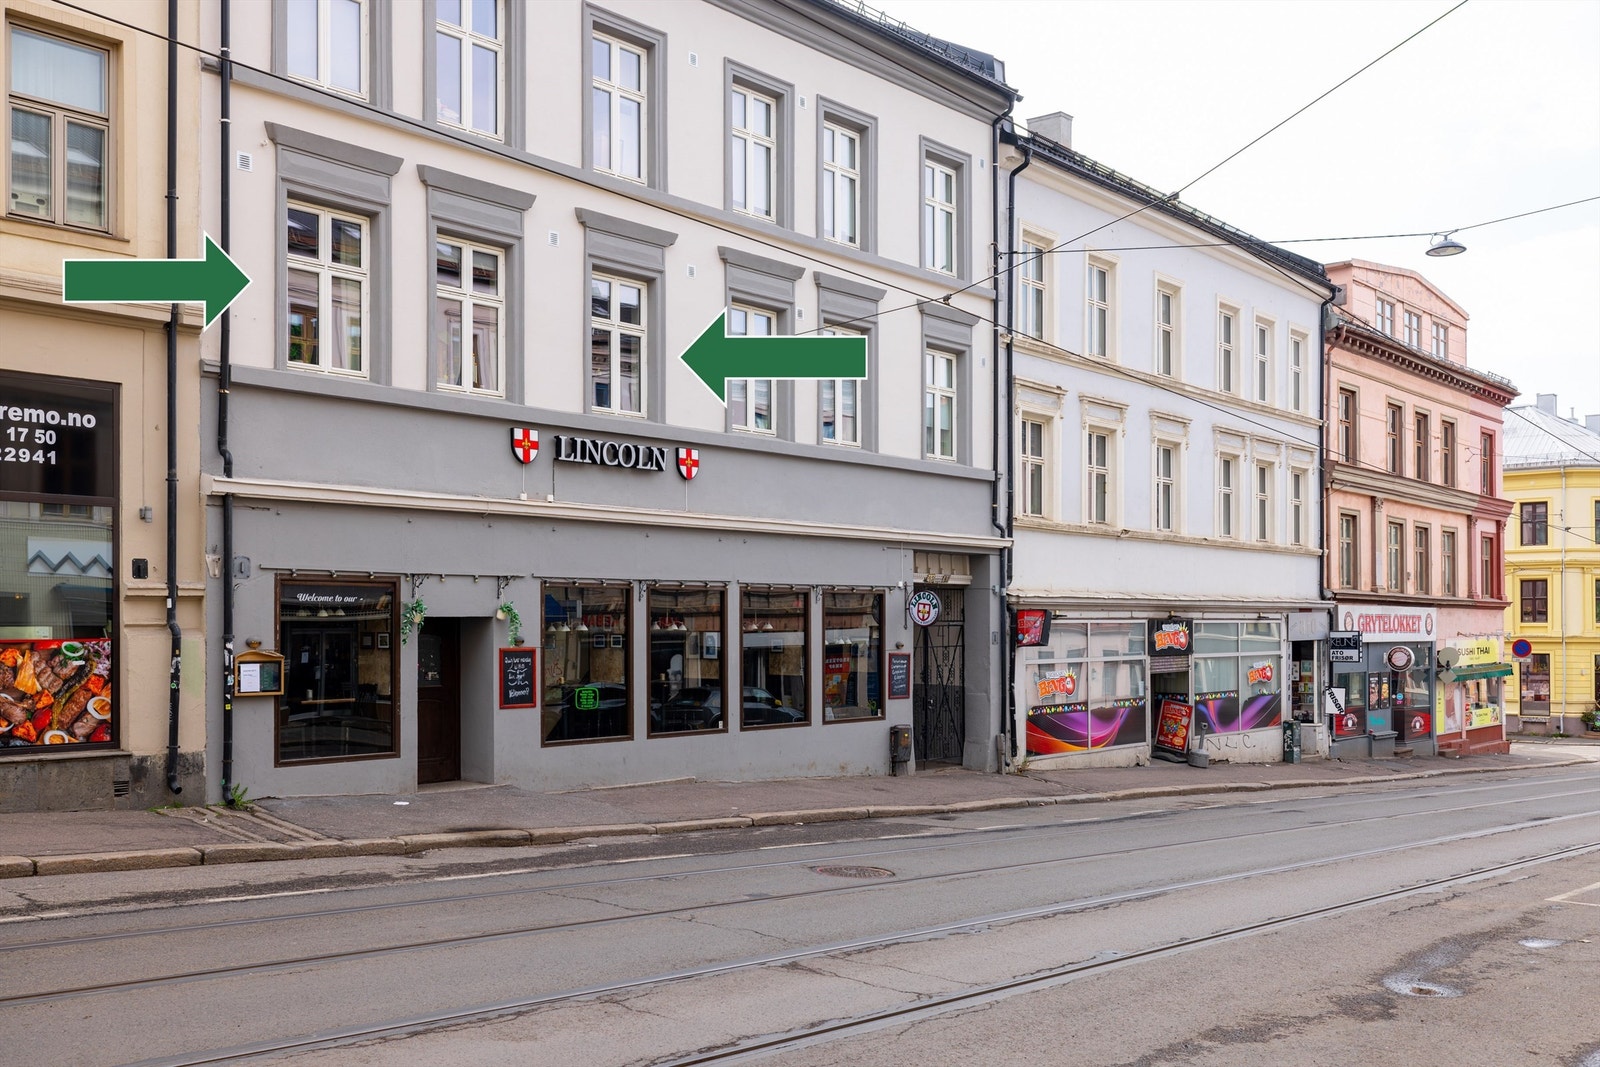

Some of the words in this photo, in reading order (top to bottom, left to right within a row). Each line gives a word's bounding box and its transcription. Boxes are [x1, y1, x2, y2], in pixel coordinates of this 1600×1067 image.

[6, 426, 29, 442] 17
[34, 429, 57, 445] 50
[0, 447, 56, 465] 2941
[555, 435, 669, 472] LINCOLN
[296, 593, 334, 603] Welcome
[334, 594, 343, 603] to
[910, 592, 938, 610] LINCOLN
[1357, 613, 1422, 634] GRYTELOKKET
[1154, 630, 1189, 650] BINGO
[1331, 637, 1357, 647] KEUNE
[1457, 647, 1476, 656] SUSHI
[1476, 646, 1490, 655] THAI
[1038, 676, 1075, 698] BINGO
